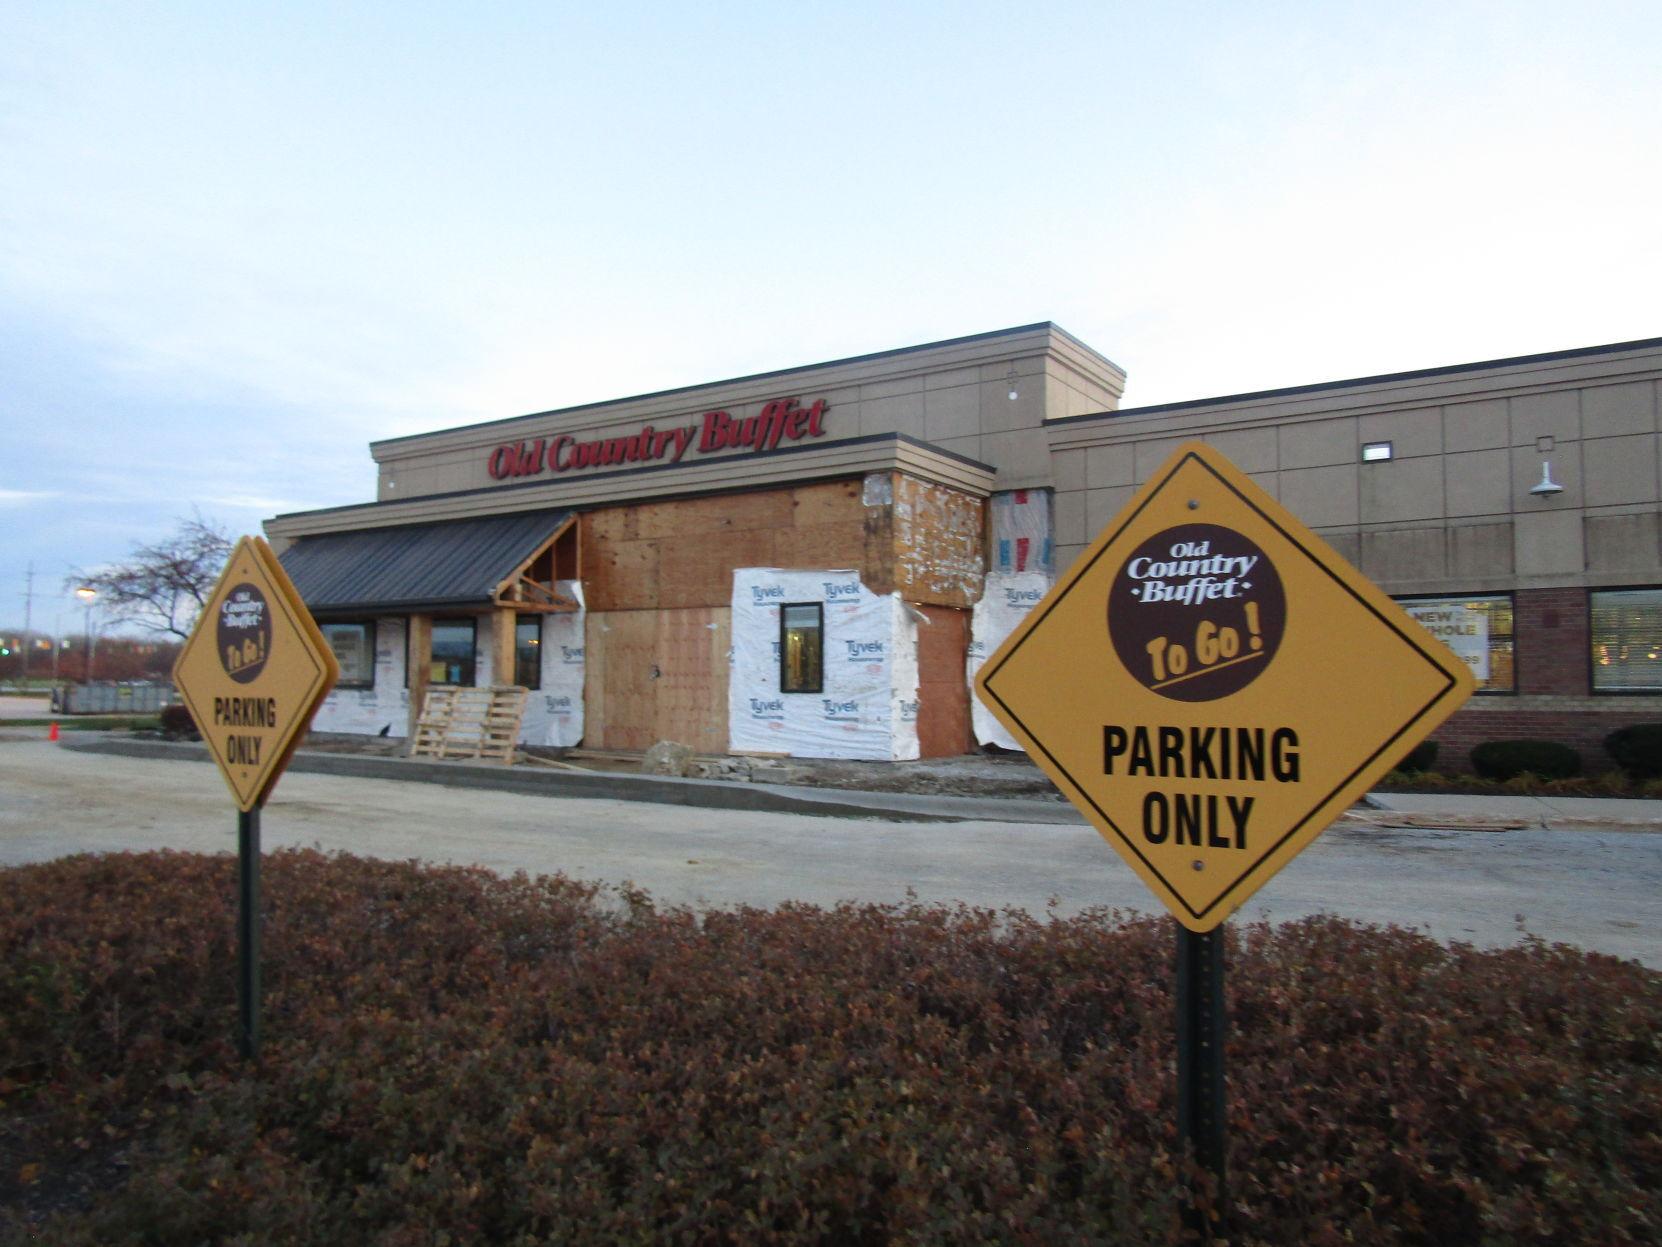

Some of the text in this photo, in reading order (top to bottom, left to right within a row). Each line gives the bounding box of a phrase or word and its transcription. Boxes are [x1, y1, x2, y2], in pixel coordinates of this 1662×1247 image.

[488, 398, 830, 480] Old Country Buffet
[1170, 541, 1210, 558] Old
[1127, 554, 1258, 580] Country
[751, 585, 785, 601] Tyvek
[822, 581, 860, 599] Tyvek
[1139, 576, 1239, 606] Buffet
[845, 640, 884, 656] Tyvek
[1146, 636, 1189, 681] To
[214, 697, 276, 728] PARKING
[750, 698, 785, 714] Tyvek
[822, 699, 860, 715] Tyvek
[227, 734, 262, 766] ONLY
[1102, 725, 1301, 783] PARKING
[1142, 791, 1256, 850] ONLY
